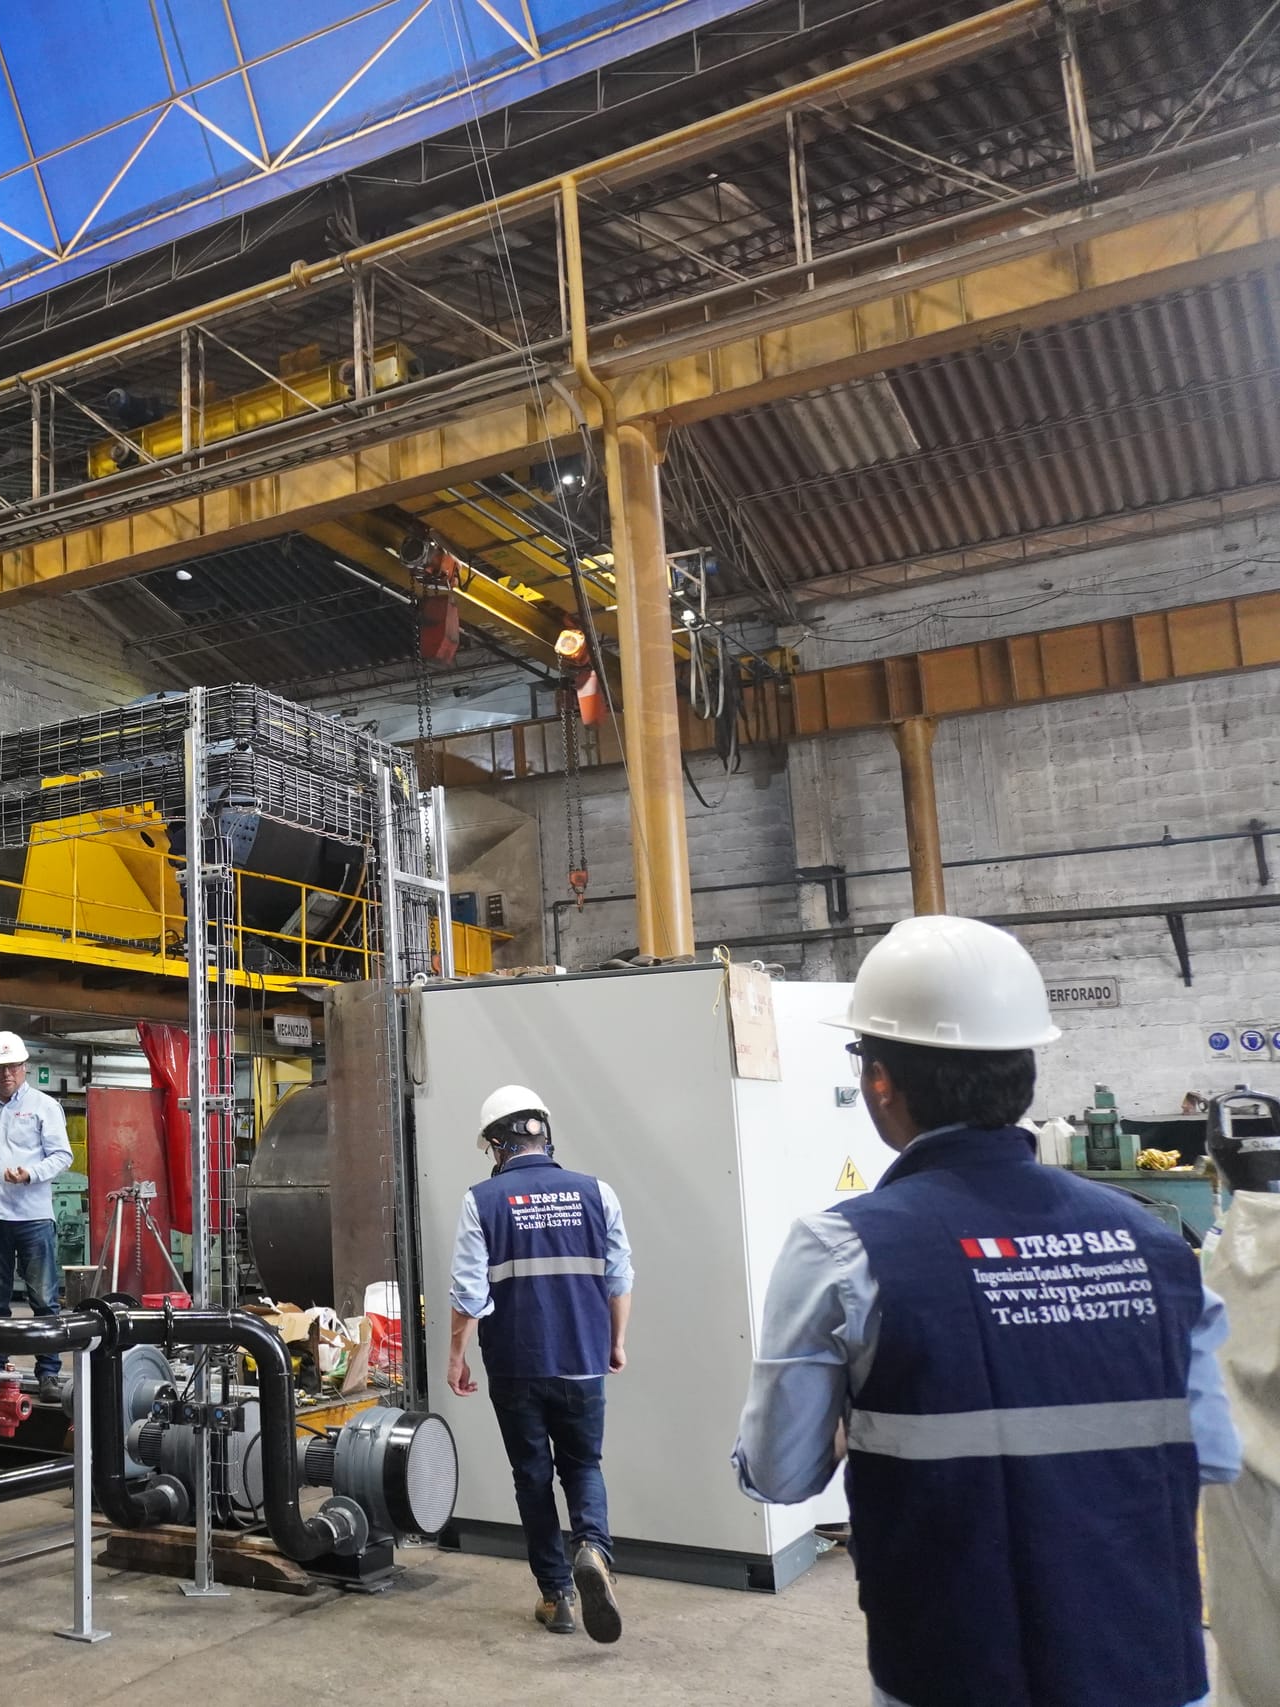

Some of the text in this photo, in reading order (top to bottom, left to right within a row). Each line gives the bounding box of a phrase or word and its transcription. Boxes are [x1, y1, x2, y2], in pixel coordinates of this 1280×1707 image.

[1047, 987, 1111, 1002] ERFORADO
[276, 1023, 309, 1038] MECANIZADO
[530, 1191, 580, 1204] IT&P SAS
[1013, 1229, 1136, 1259] IT&P SAS
[984, 1279, 1152, 1303] www.ityp.com.co
